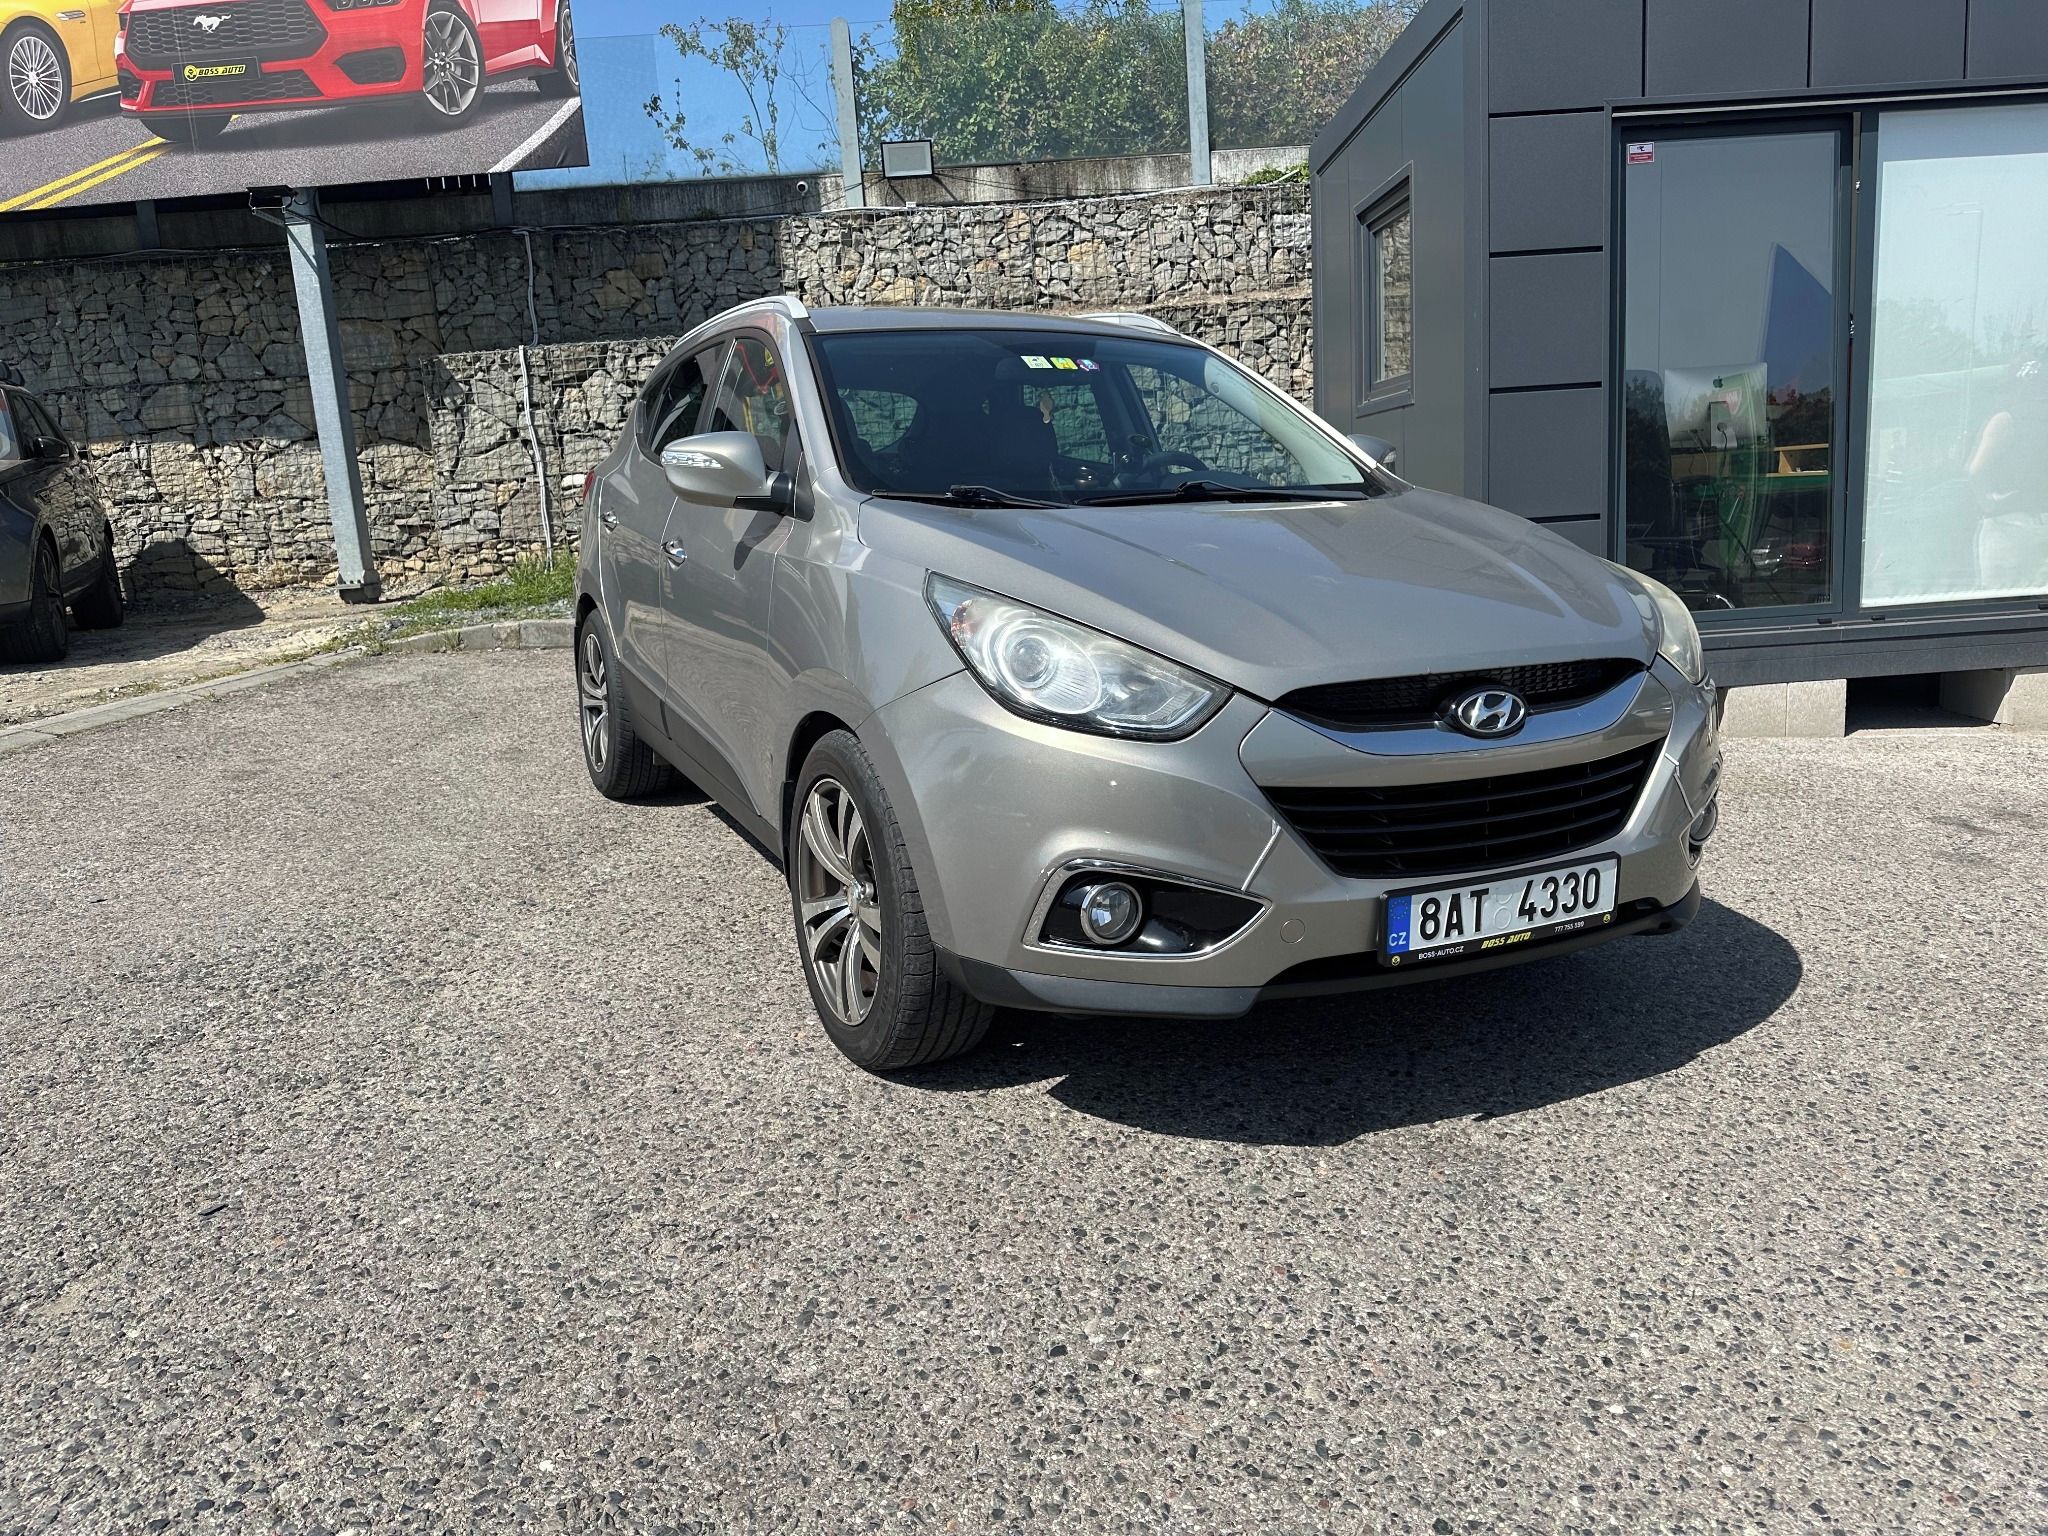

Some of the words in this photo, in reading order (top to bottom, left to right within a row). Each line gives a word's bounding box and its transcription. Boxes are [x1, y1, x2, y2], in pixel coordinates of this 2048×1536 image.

[198, 68, 219, 76] BOSS
[222, 66, 244, 74] AUTO
[1419, 888, 1490, 941] 8AT
[1517, 867, 1601, 922] 4330
[1389, 932, 1407, 947] CZ
[1481, 936, 1505, 949] BOSS
[1506, 931, 1532, 944] AUTO
[1418, 945, 1465, 960] BOSS-AUTO.CZ
